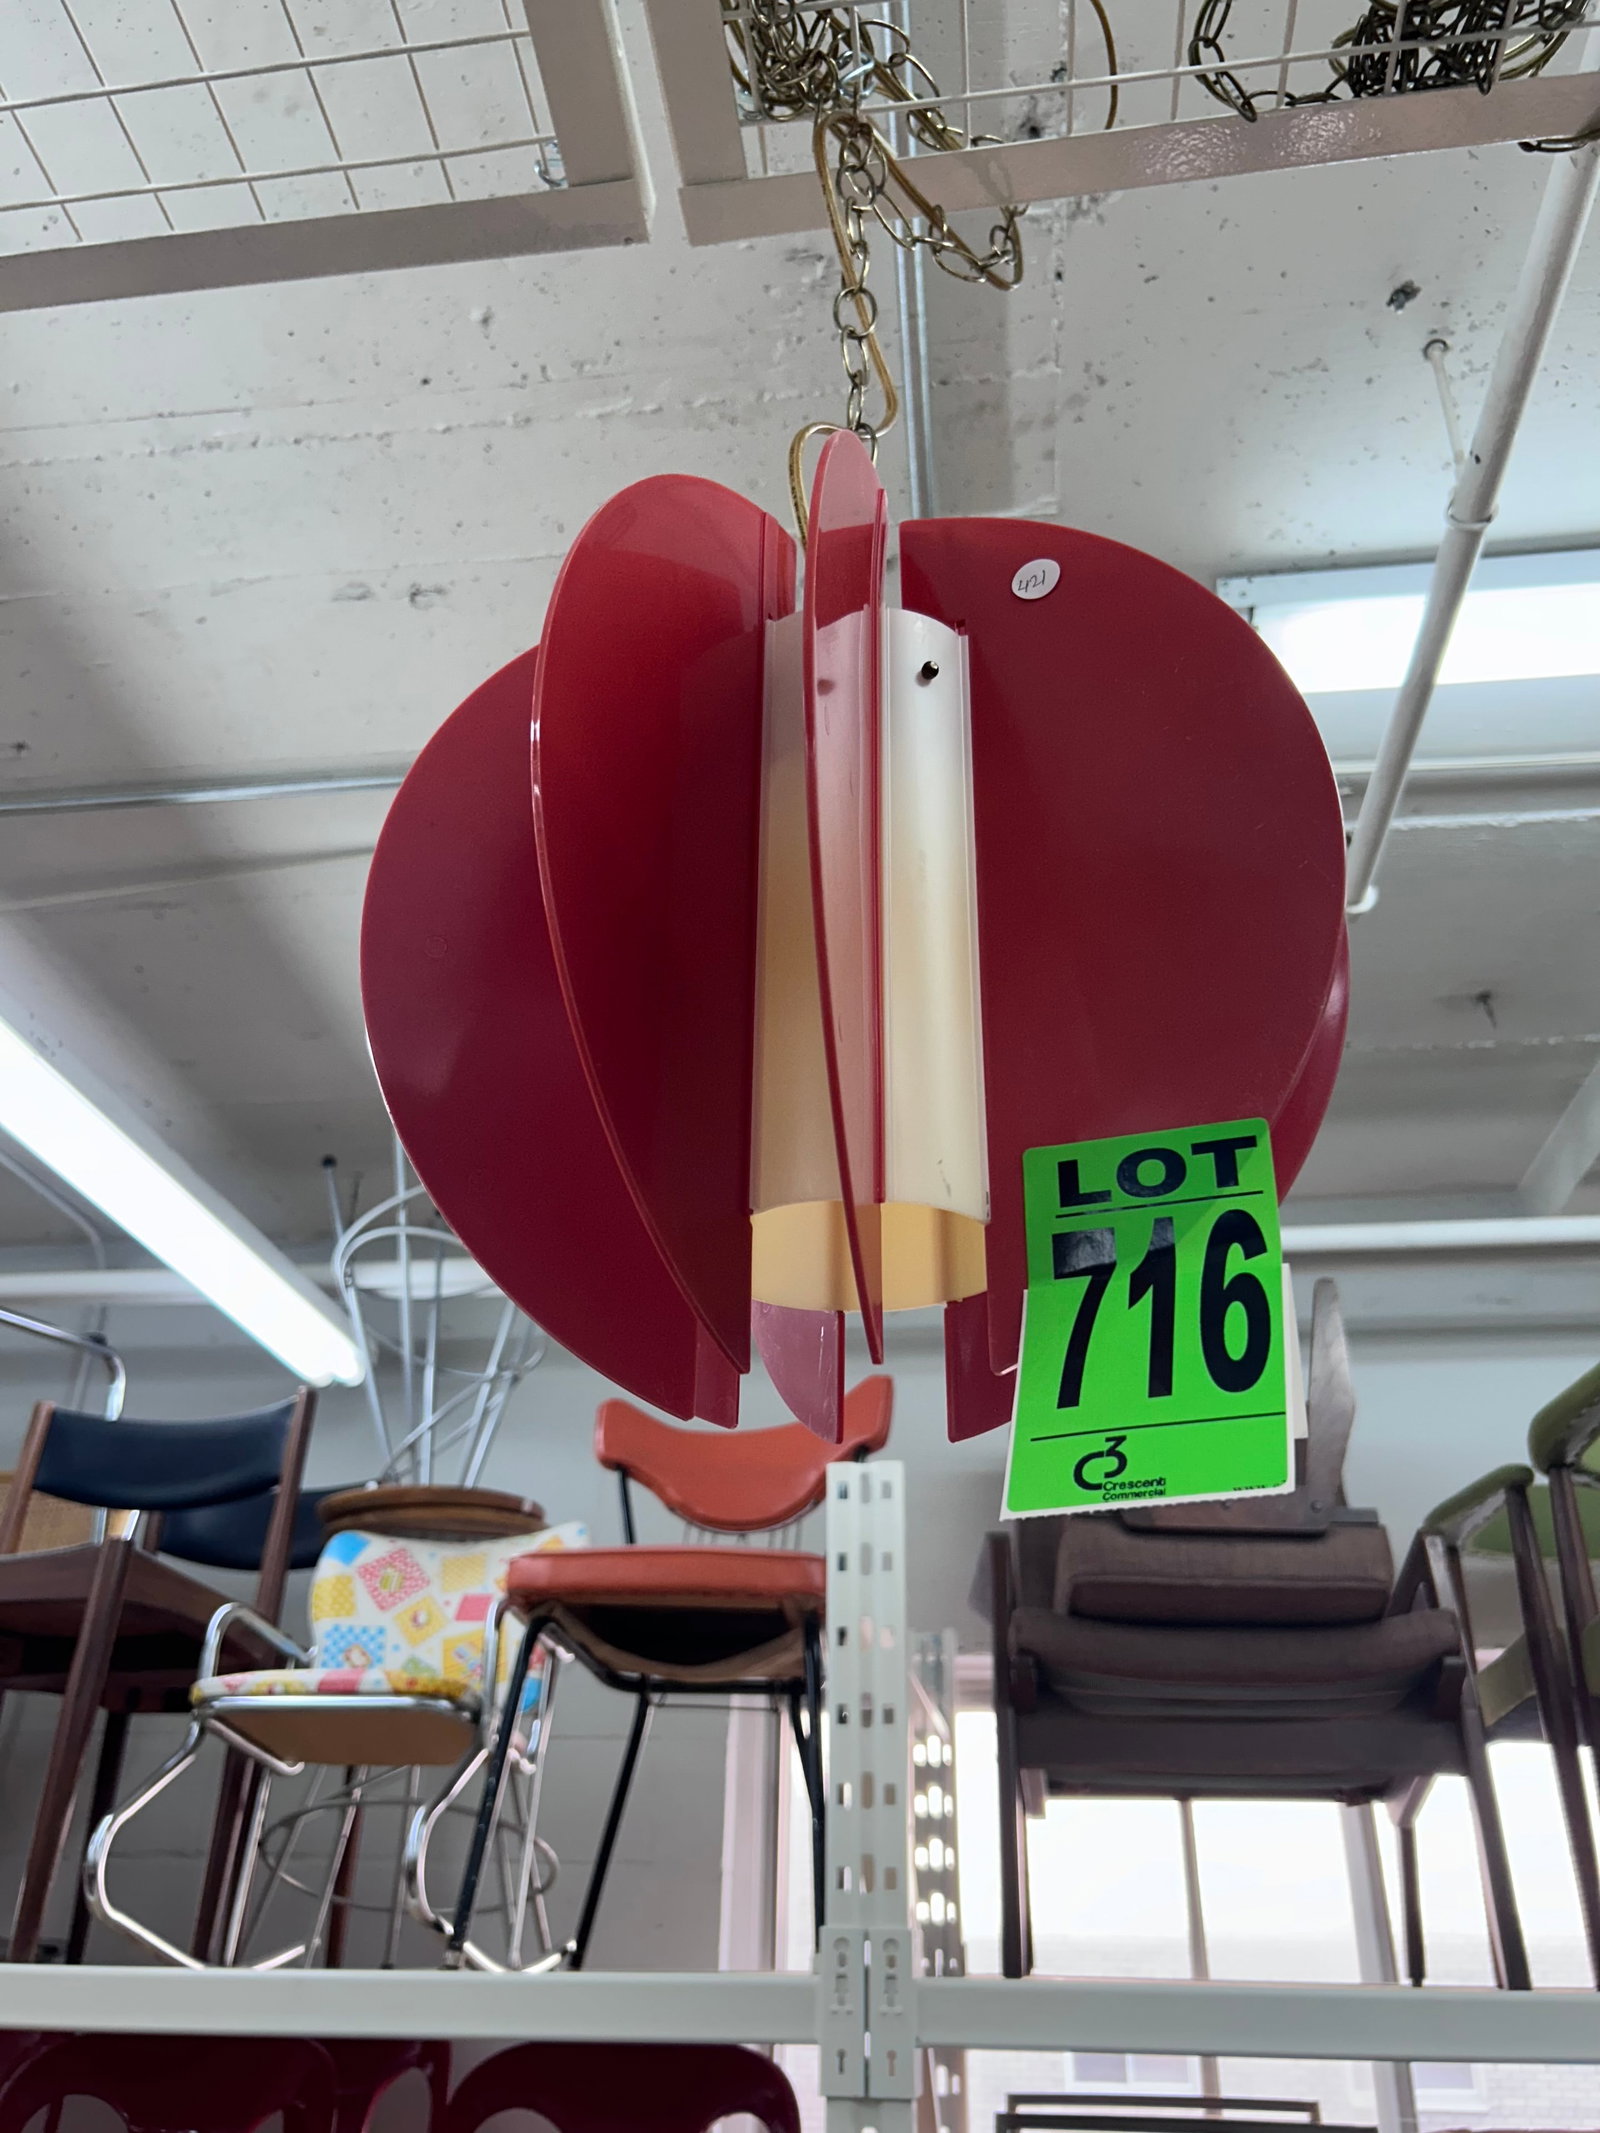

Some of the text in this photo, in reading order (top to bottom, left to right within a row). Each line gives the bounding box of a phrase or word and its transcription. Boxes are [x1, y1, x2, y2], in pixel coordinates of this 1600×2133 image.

[1017, 569, 1046, 593] 421
[1057, 1135, 1258, 1209] LOT
[1051, 1209, 1272, 1410] 716
[1102, 1487, 1166, 1501] Commercial
[1103, 1476, 1166, 1492] Crescent
